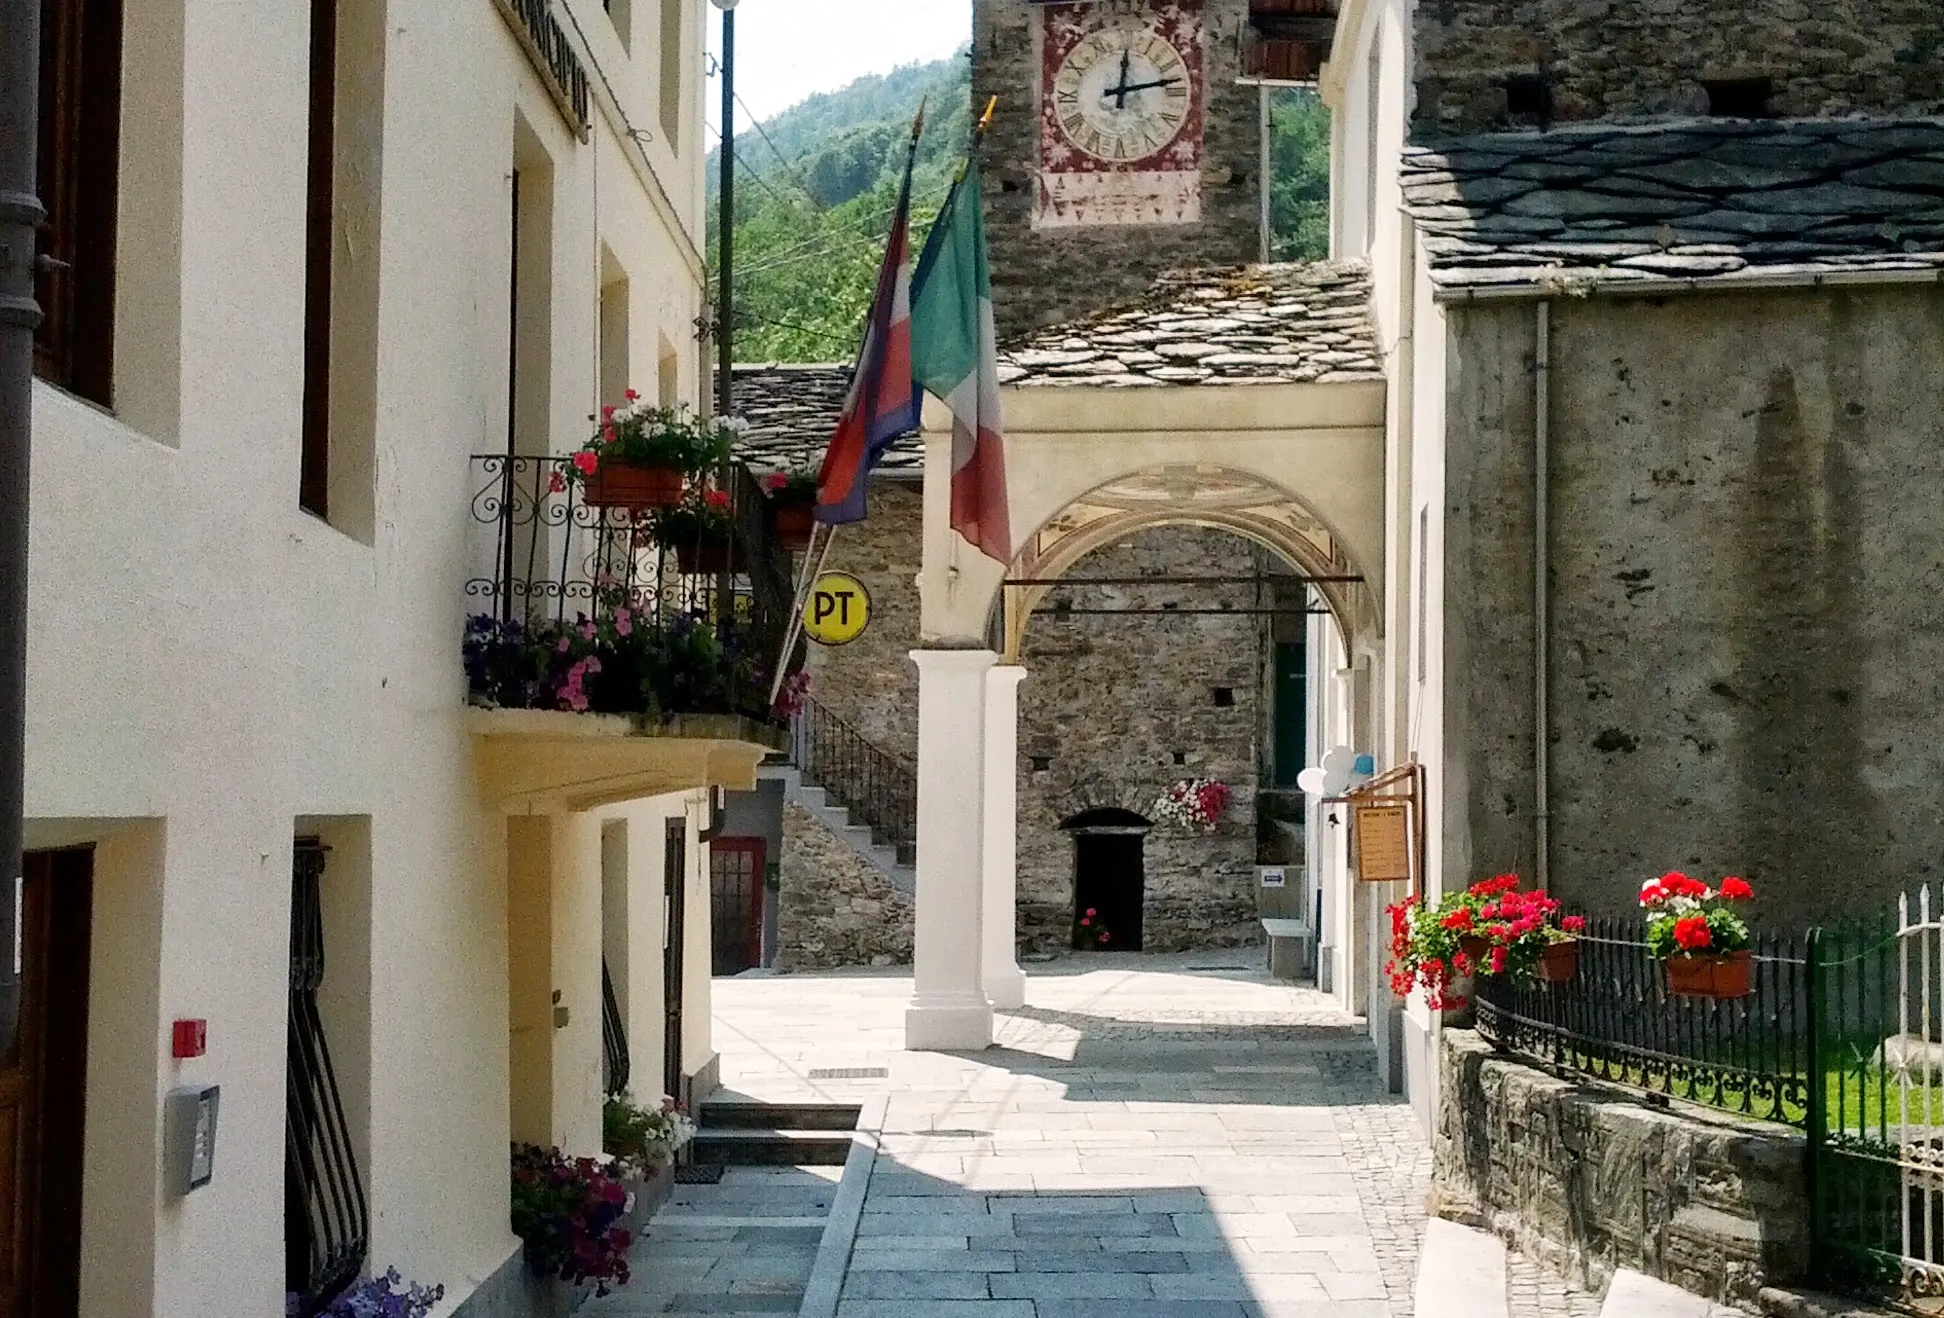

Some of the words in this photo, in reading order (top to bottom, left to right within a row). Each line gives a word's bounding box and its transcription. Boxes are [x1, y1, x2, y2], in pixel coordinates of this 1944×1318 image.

[1065, 59, 1085, 77] X
[1057, 90, 1078, 103] IX
[1165, 87, 1186, 97] III
[814, 591, 854, 625] PT
